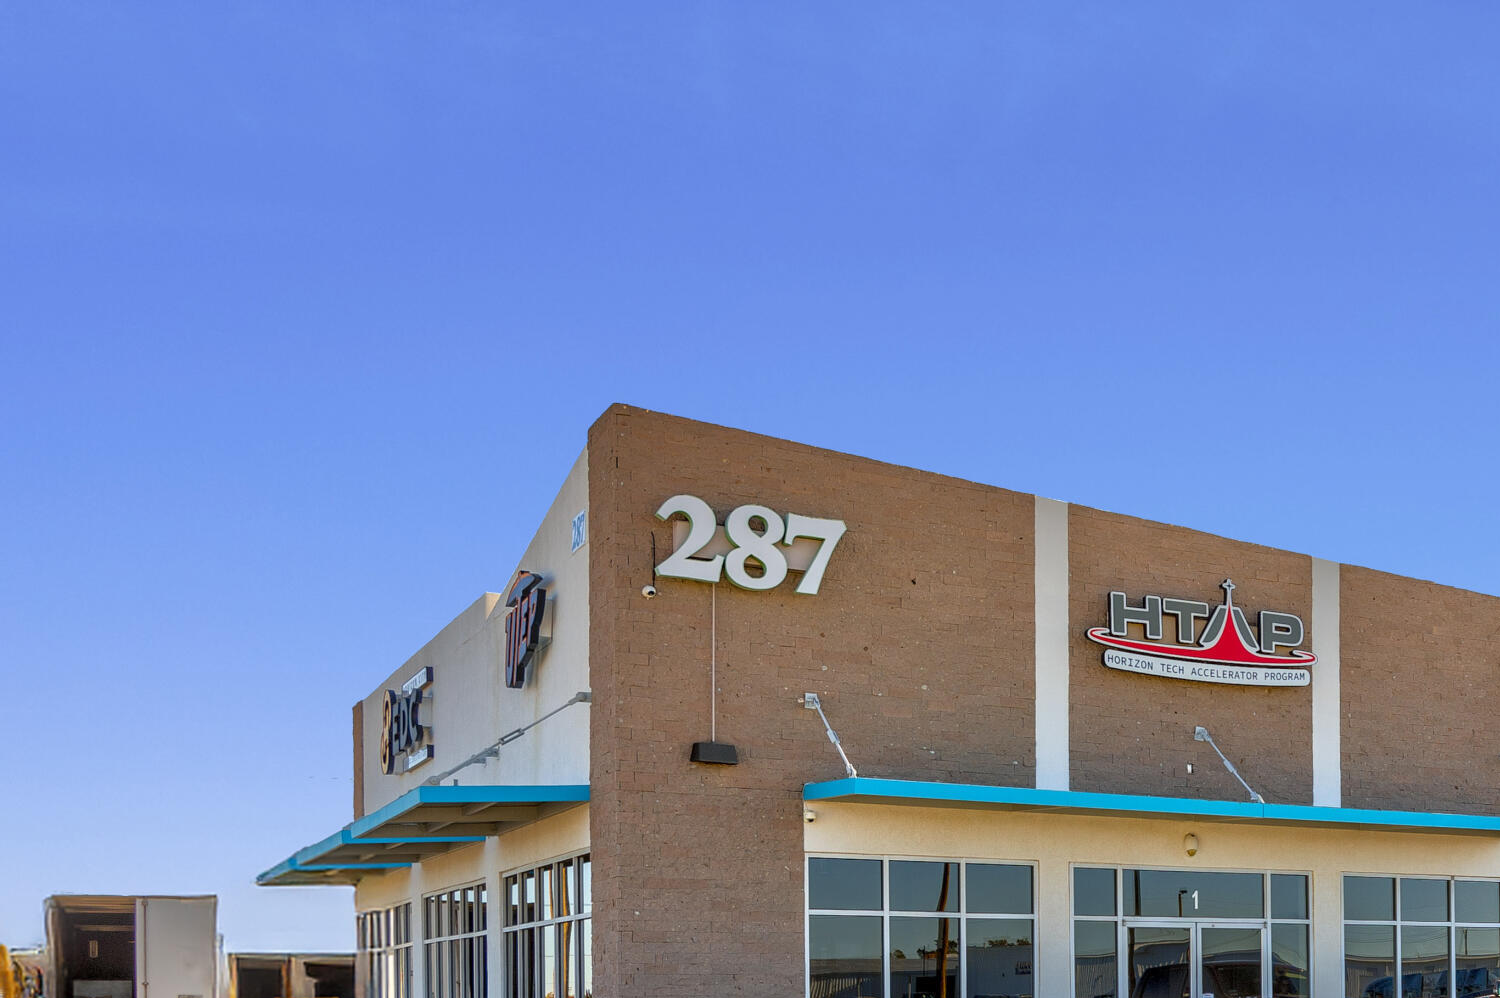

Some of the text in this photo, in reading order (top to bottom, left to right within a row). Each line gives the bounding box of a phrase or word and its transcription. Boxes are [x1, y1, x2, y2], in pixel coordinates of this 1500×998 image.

[572, 512, 585, 549] 287
[655, 494, 848, 595] 287
[1109, 590, 1304, 653] HTAP
[1107, 654, 1305, 681] HORIZON TECH ACCELERATOR PROGRAM
[1191, 890, 1199, 909] 1
